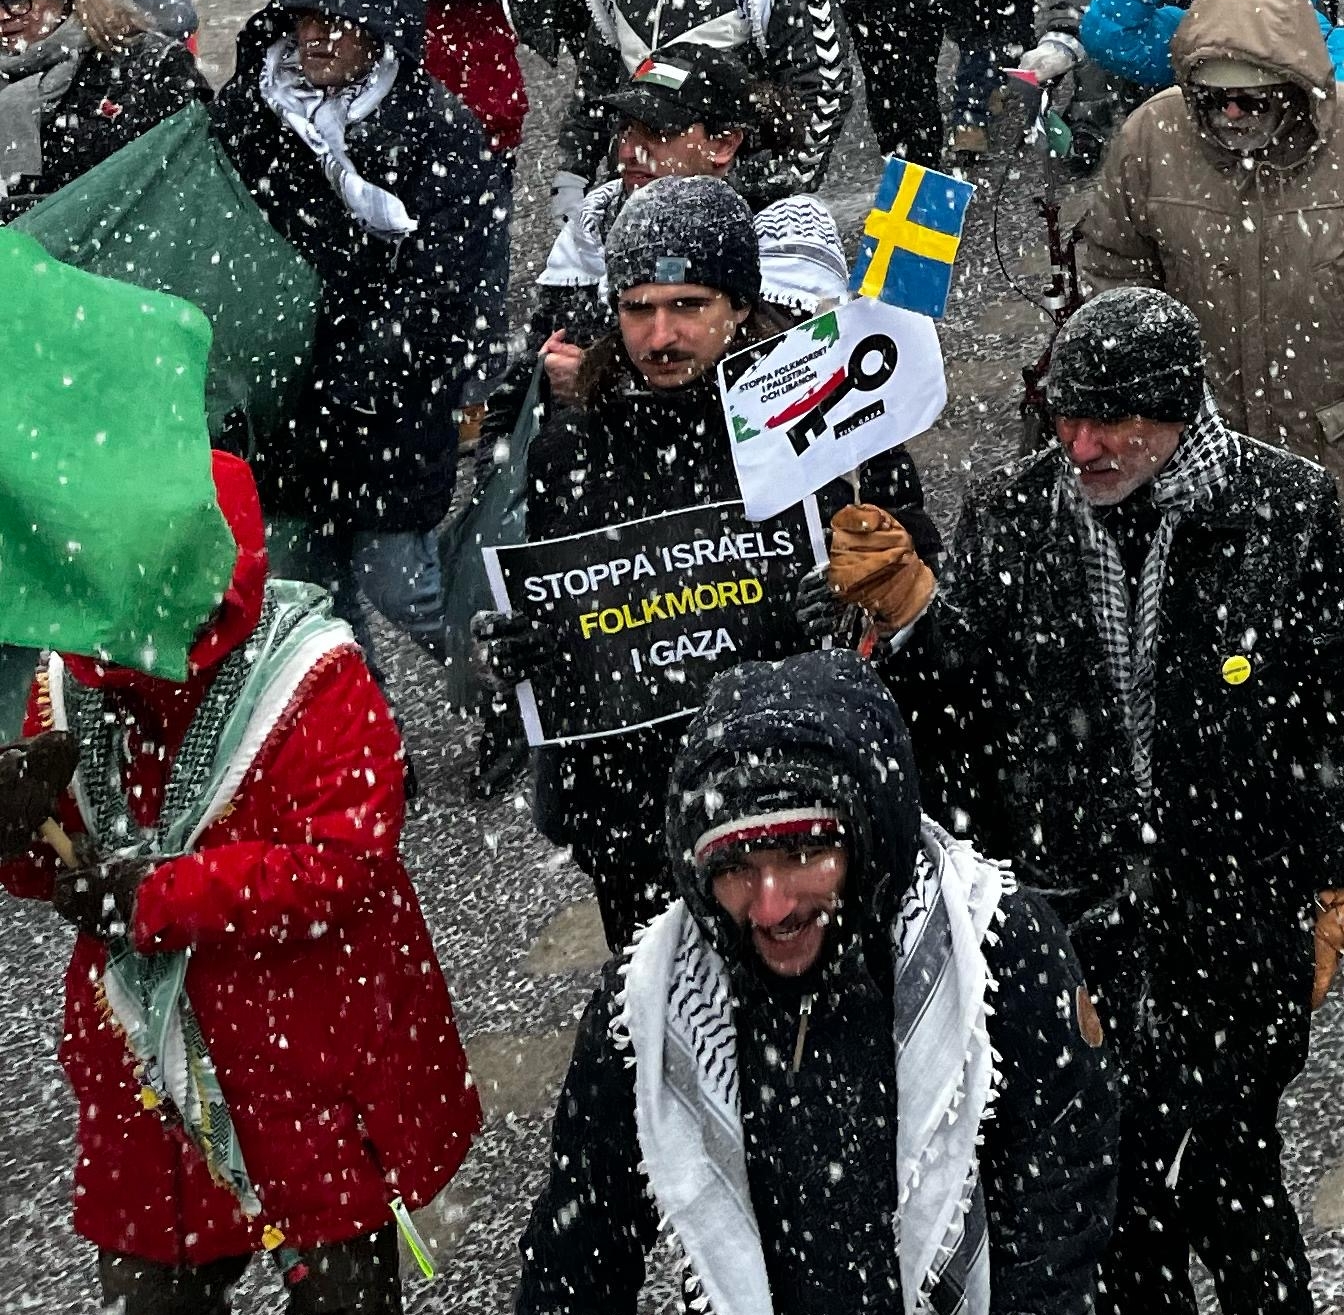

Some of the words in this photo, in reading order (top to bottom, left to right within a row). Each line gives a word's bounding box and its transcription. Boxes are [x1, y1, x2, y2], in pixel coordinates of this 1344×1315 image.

[739, 372, 773, 393] STOPPA
[760, 389, 781, 404] OCH
[524, 552, 656, 602] STOPPA
[661, 530, 794, 573] ISRAELS
[579, 578, 764, 640] FOLKMORD
[631, 648, 642, 674] I
[650, 627, 737, 667] GAZA
